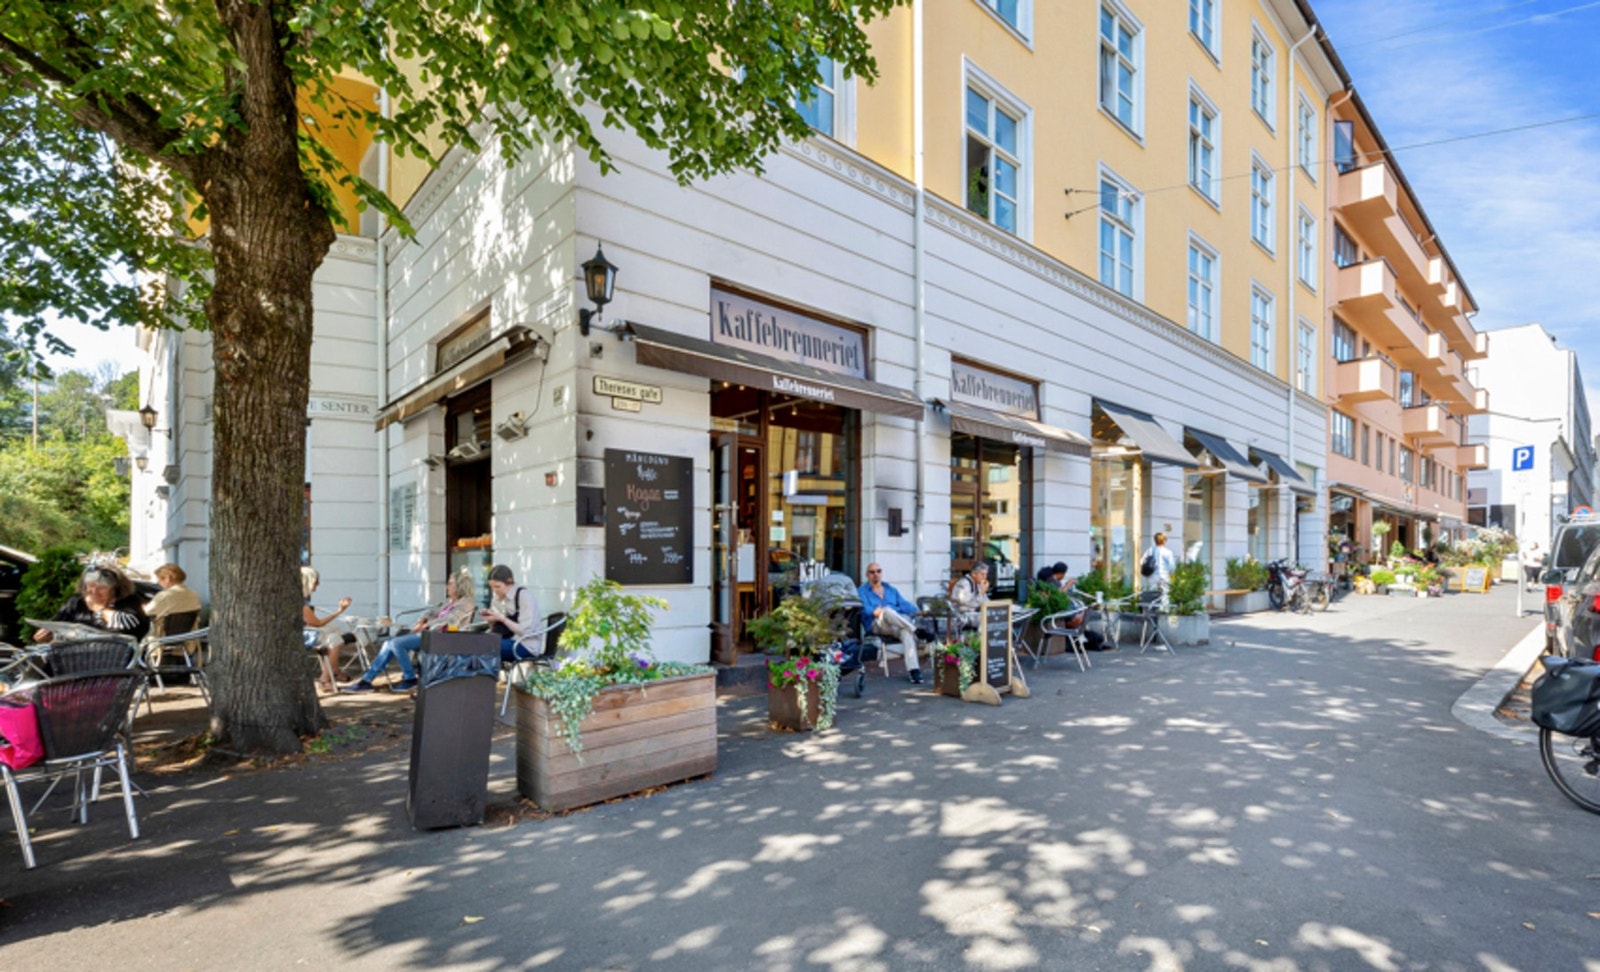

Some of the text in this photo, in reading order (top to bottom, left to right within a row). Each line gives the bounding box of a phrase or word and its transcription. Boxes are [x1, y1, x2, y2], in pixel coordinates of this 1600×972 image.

[717, 300, 860, 371] Kaffebrenneriet
[599, 379, 637, 396] Thereses
[951, 369, 1035, 411] Kaffebrenneriet
[321, 401, 370, 414] SENTER
[1516, 449, 1530, 468] P
